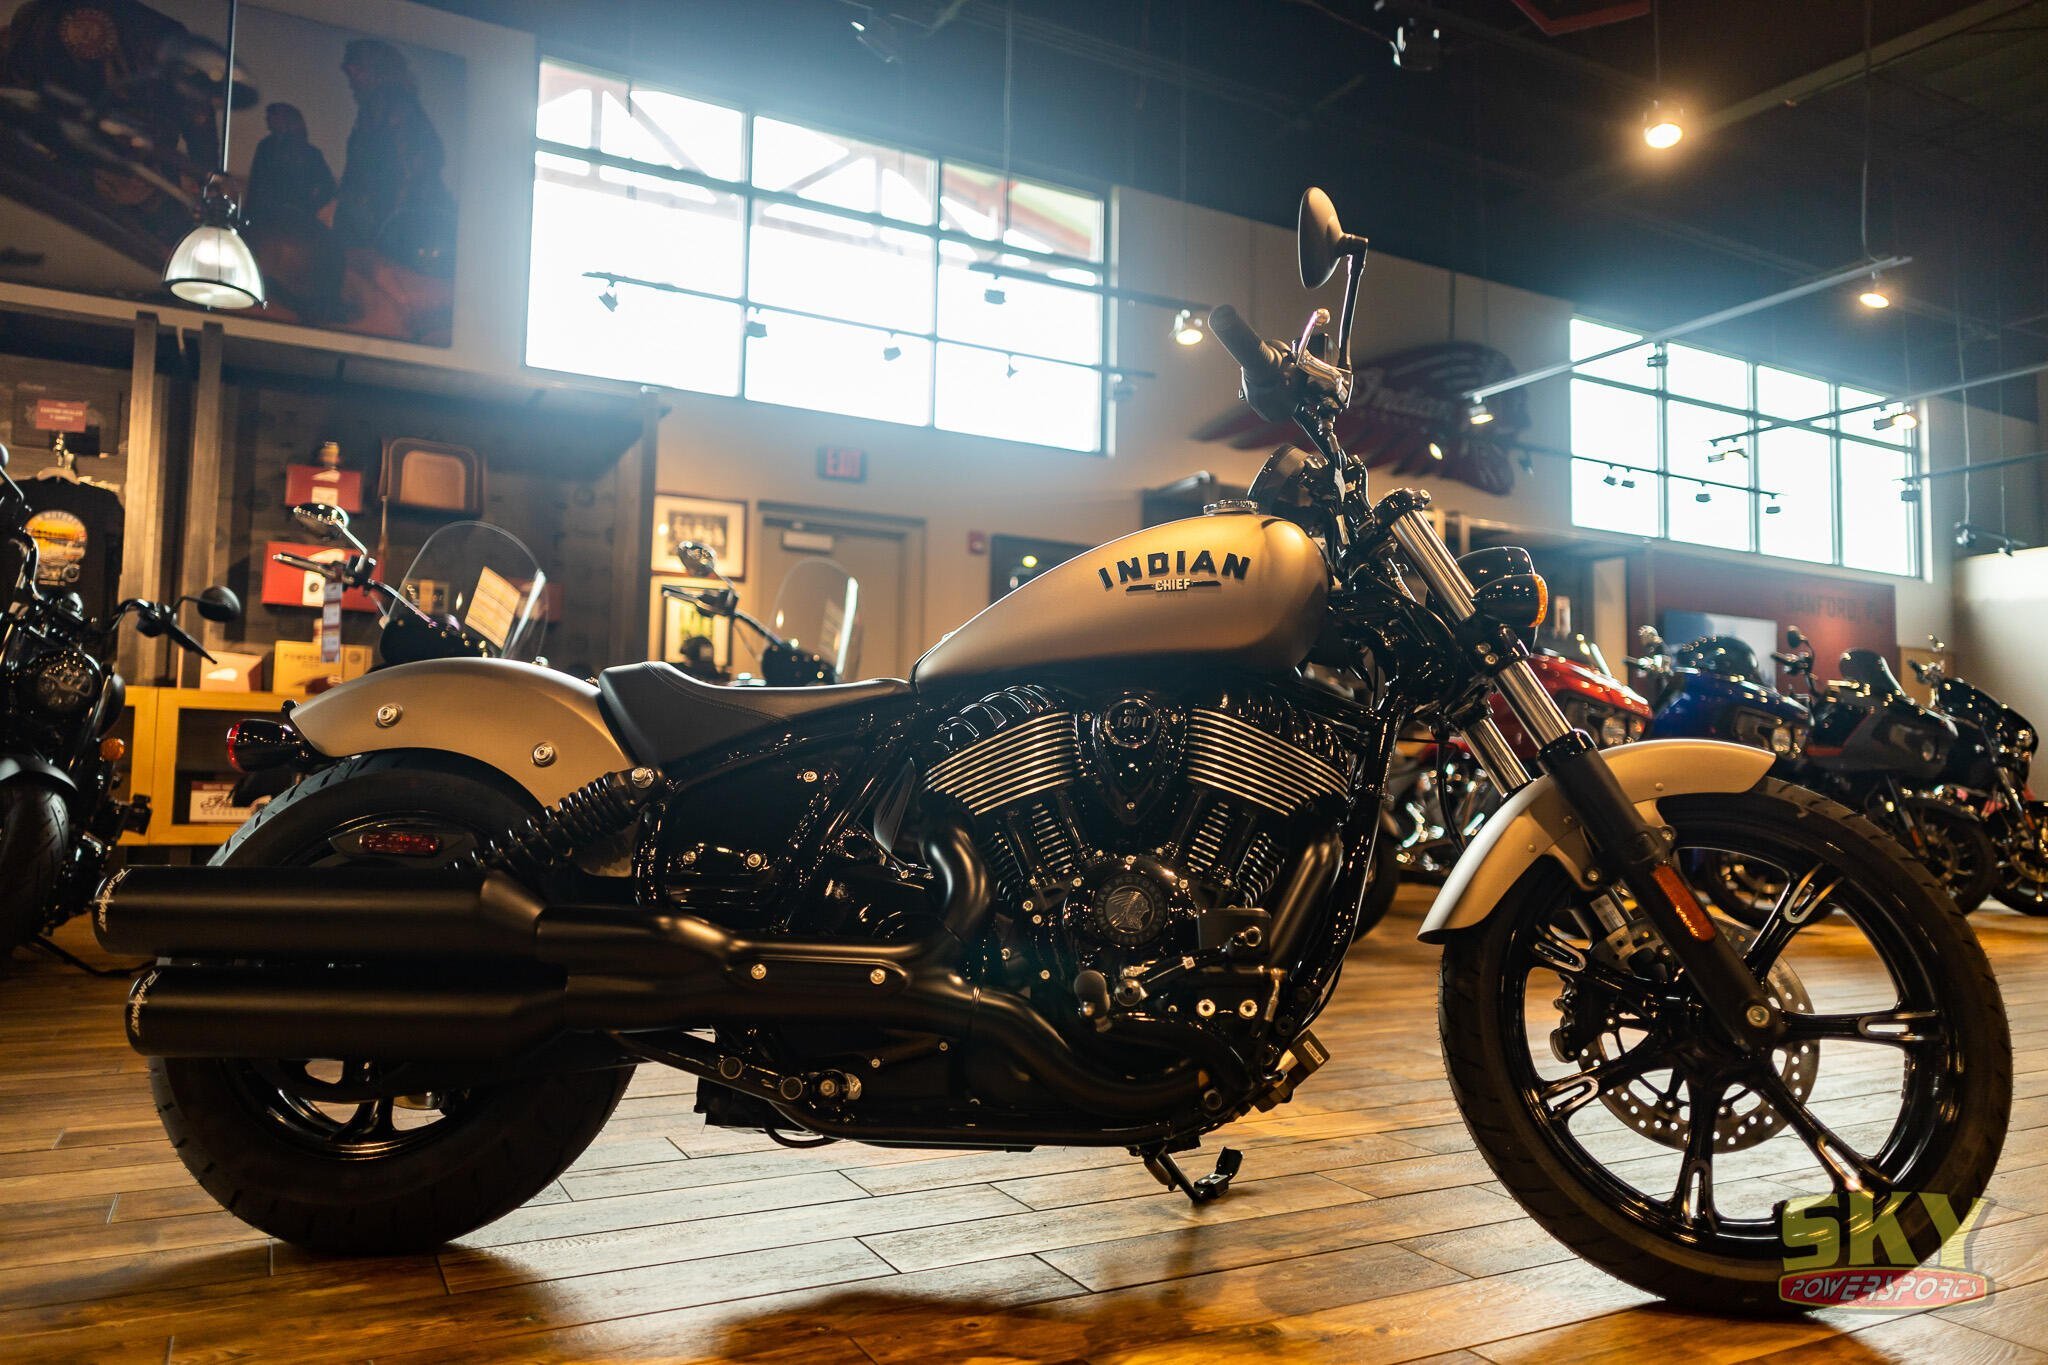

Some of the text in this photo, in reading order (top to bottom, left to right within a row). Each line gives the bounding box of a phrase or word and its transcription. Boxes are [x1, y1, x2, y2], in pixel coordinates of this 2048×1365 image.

[826, 447, 861, 478] EXIT
[1098, 550, 1251, 591] INDIAN
[1155, 578, 1191, 591] CHIEF
[1117, 715, 1148, 728] 1901
